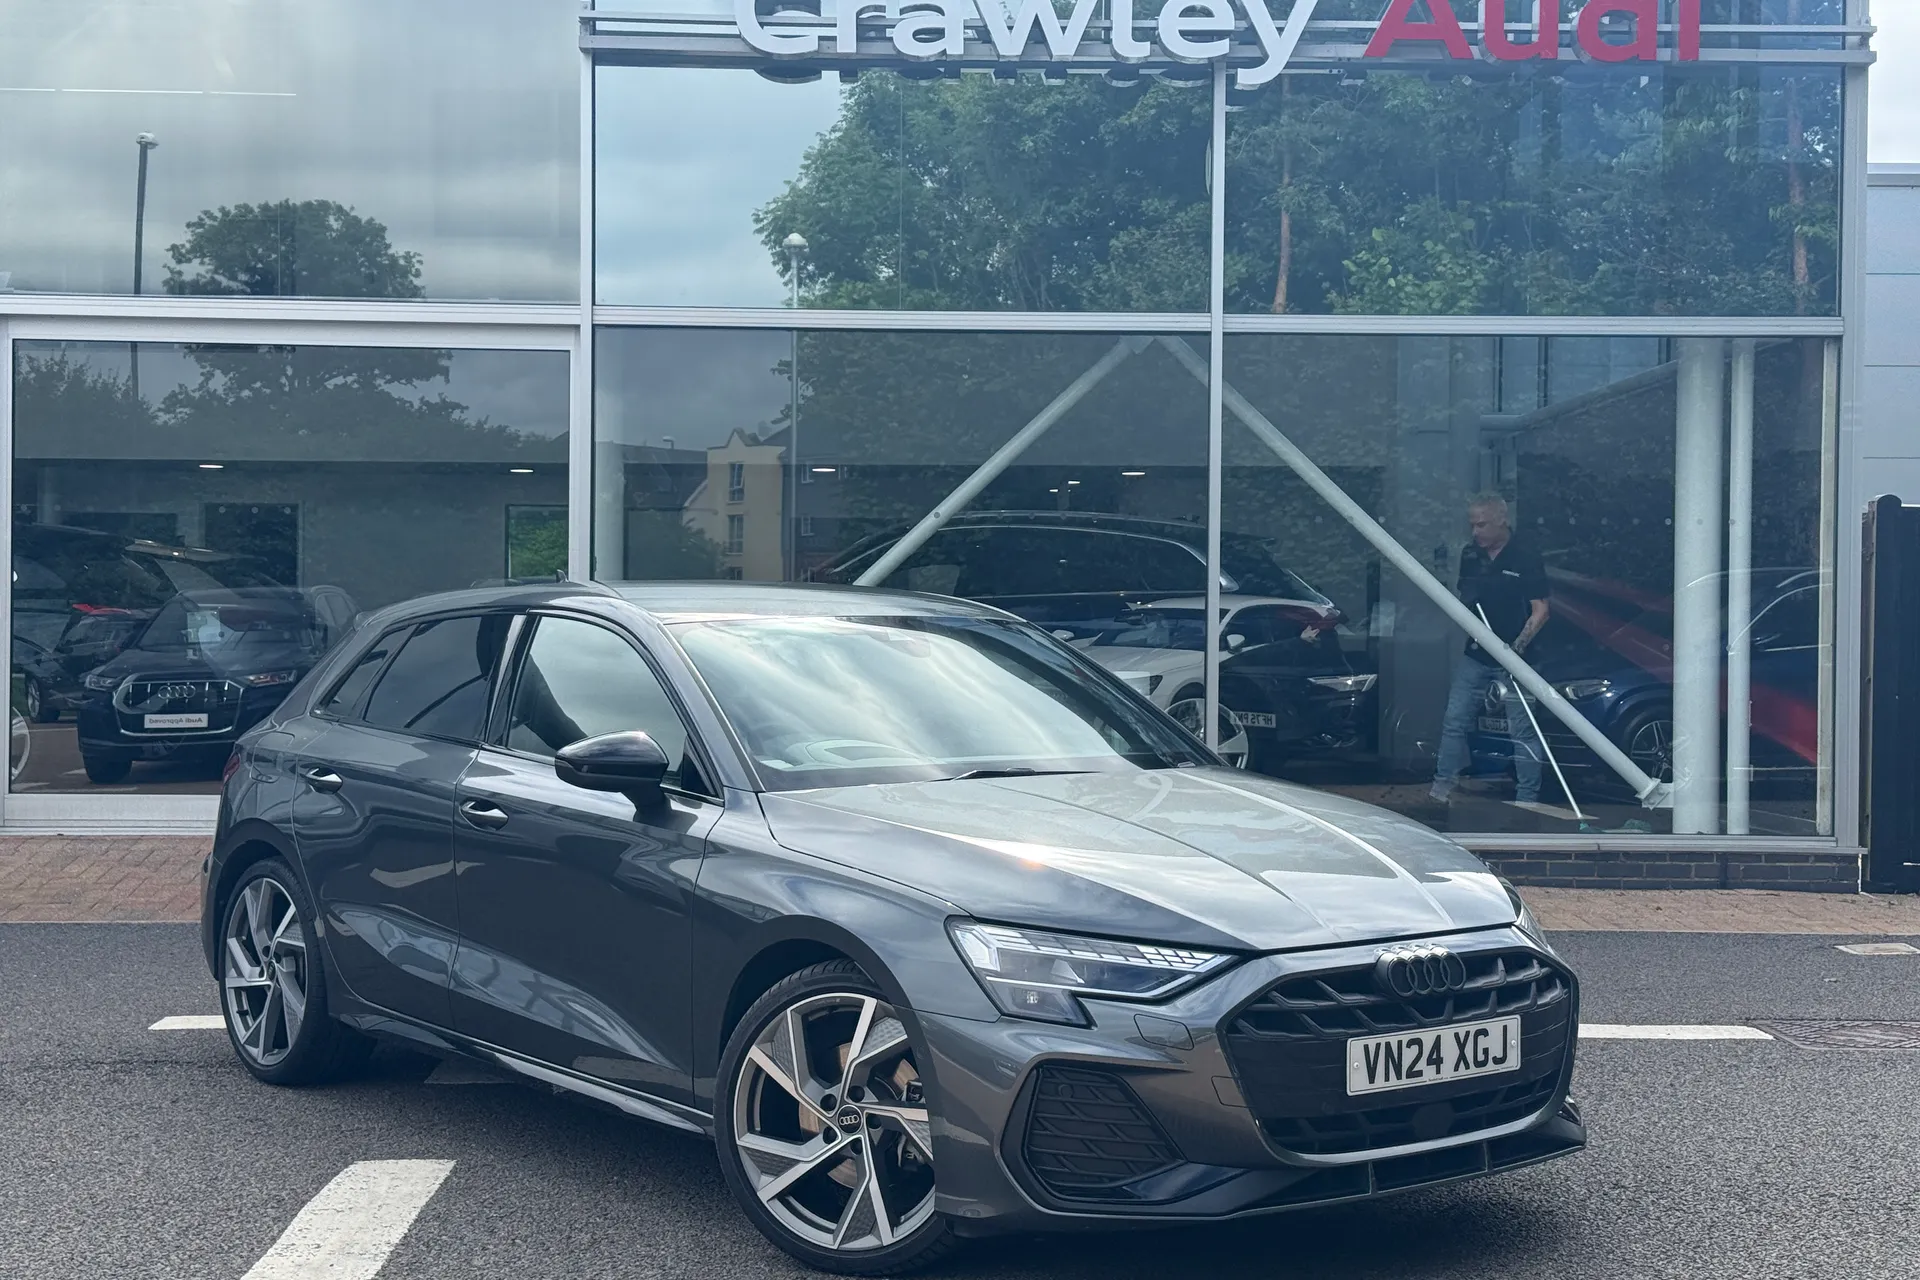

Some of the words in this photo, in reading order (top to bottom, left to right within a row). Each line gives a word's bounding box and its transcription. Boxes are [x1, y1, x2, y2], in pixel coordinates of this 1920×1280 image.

[735, 0, 1318, 84] Crawley
[1363, 0, 1700, 62] Audi
[1363, 1034, 1444, 1085] VN24
[1453, 1024, 1508, 1073] XGJ
